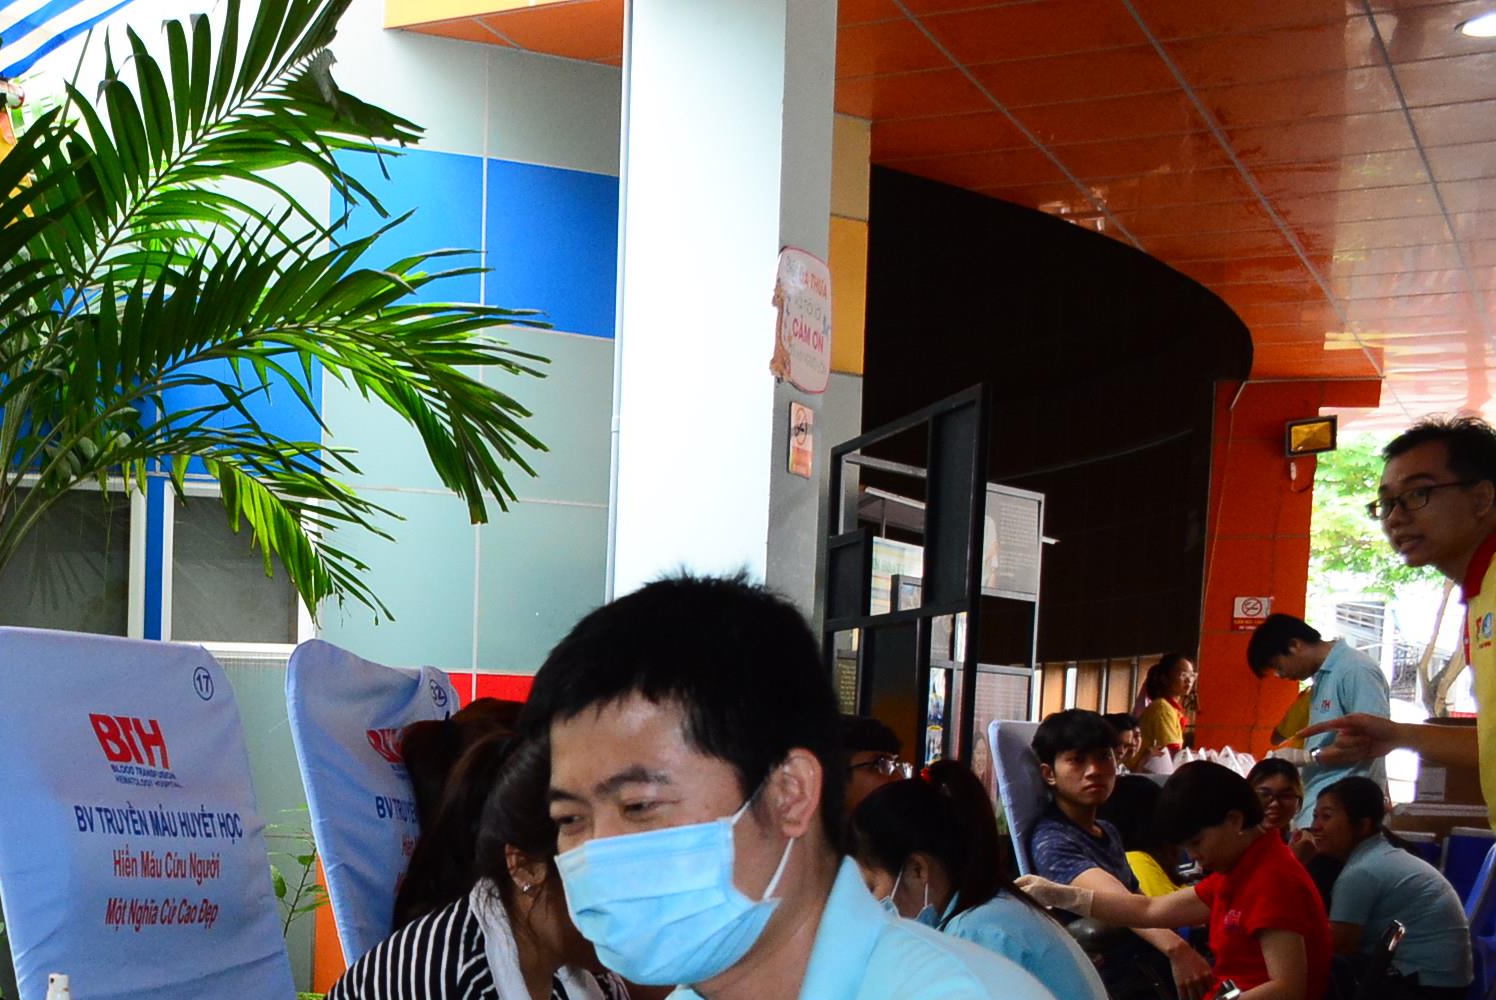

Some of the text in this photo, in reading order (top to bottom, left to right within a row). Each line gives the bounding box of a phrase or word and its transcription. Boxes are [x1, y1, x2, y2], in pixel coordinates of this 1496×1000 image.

[196, 673, 210, 692] 17
[89, 713, 170, 770] BTH
[74, 801, 243, 845] BV TRUYỀN MÁU HUYẾT HỌC
[375, 796, 392, 819] BV
[113, 844, 220, 885] Hiến Máu Cứu Người
[105, 897, 219, 932] Một Nghĩa Cử Cao Đẹp
